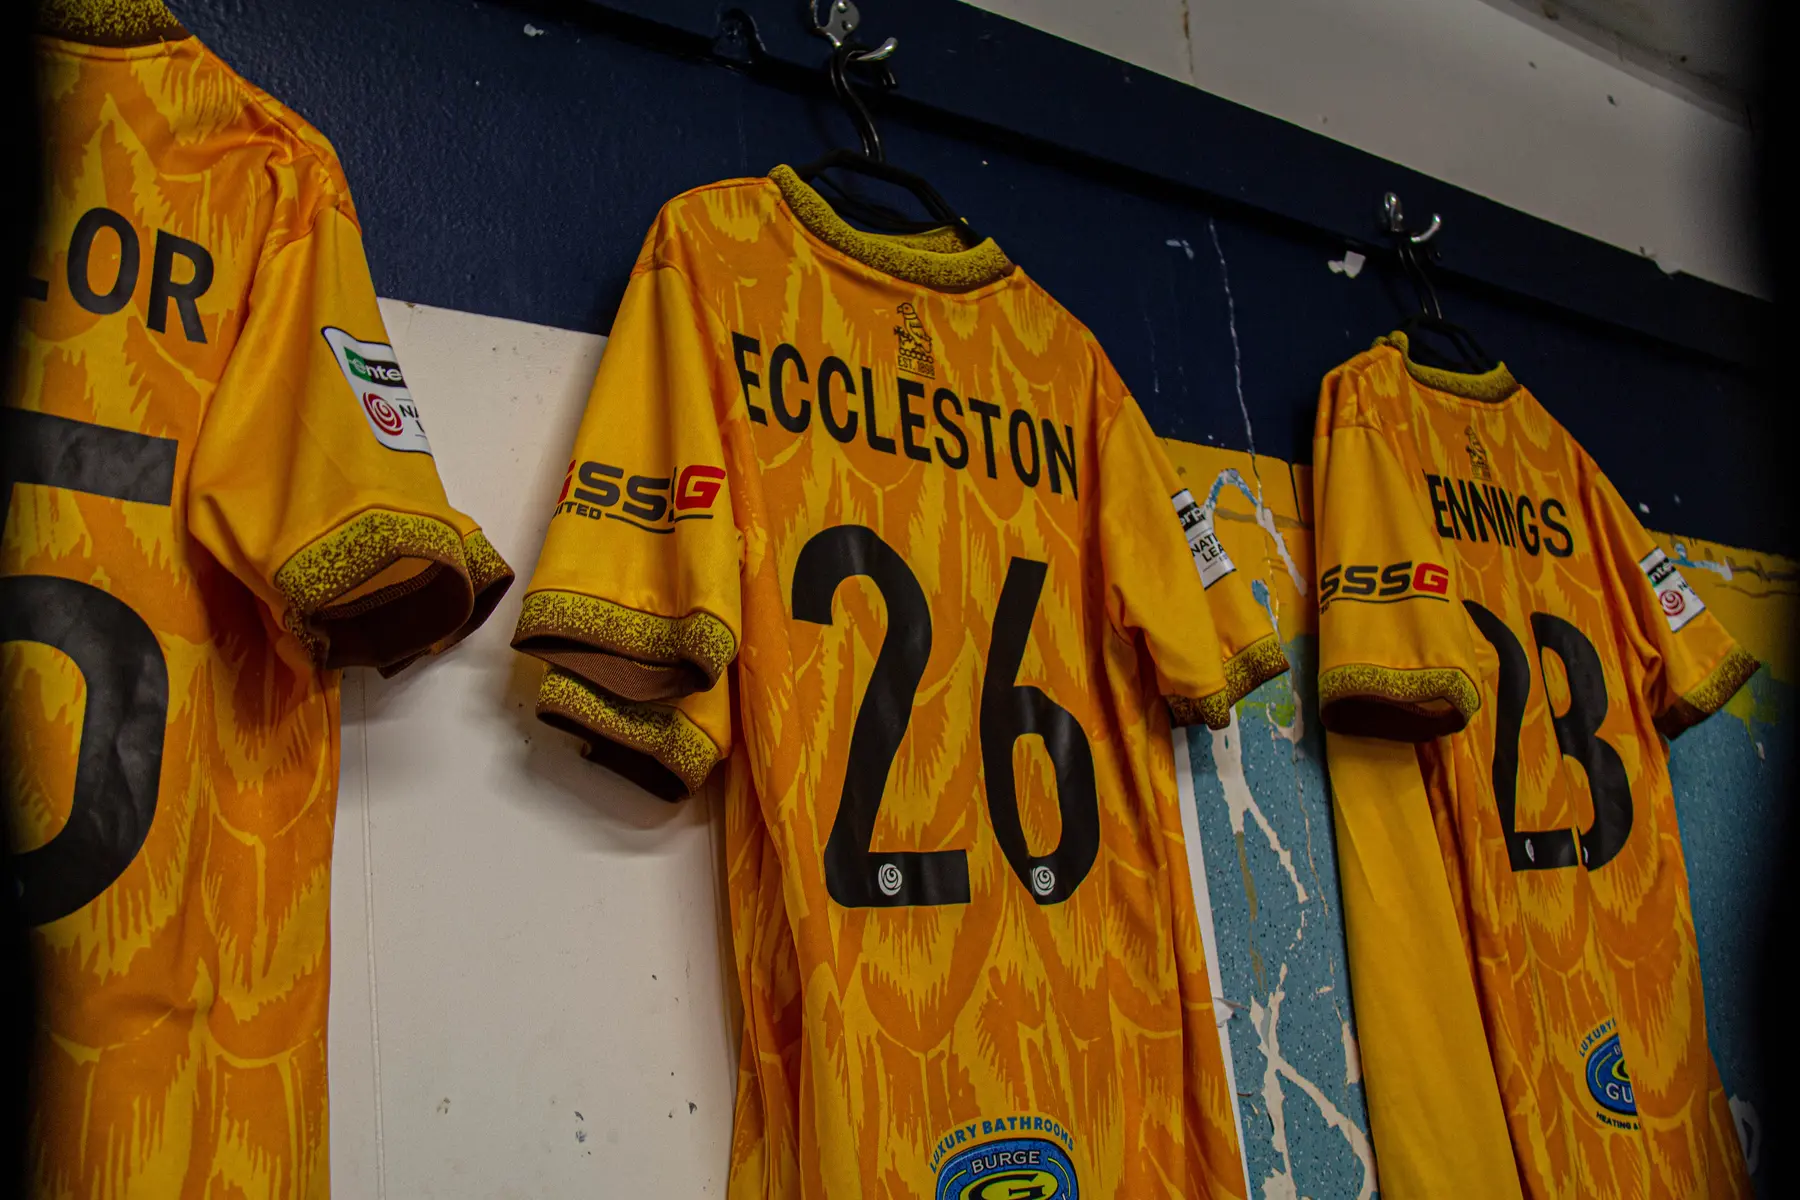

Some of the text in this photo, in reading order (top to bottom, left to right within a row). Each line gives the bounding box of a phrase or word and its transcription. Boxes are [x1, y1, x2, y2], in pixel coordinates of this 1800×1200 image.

[732, 331, 1079, 500] ECCLESTON
[792, 524, 1100, 909] 26
[929, 1116, 1074, 1174] LUXURY BATHROOMS
[971, 1151, 1040, 1174] BURGE
